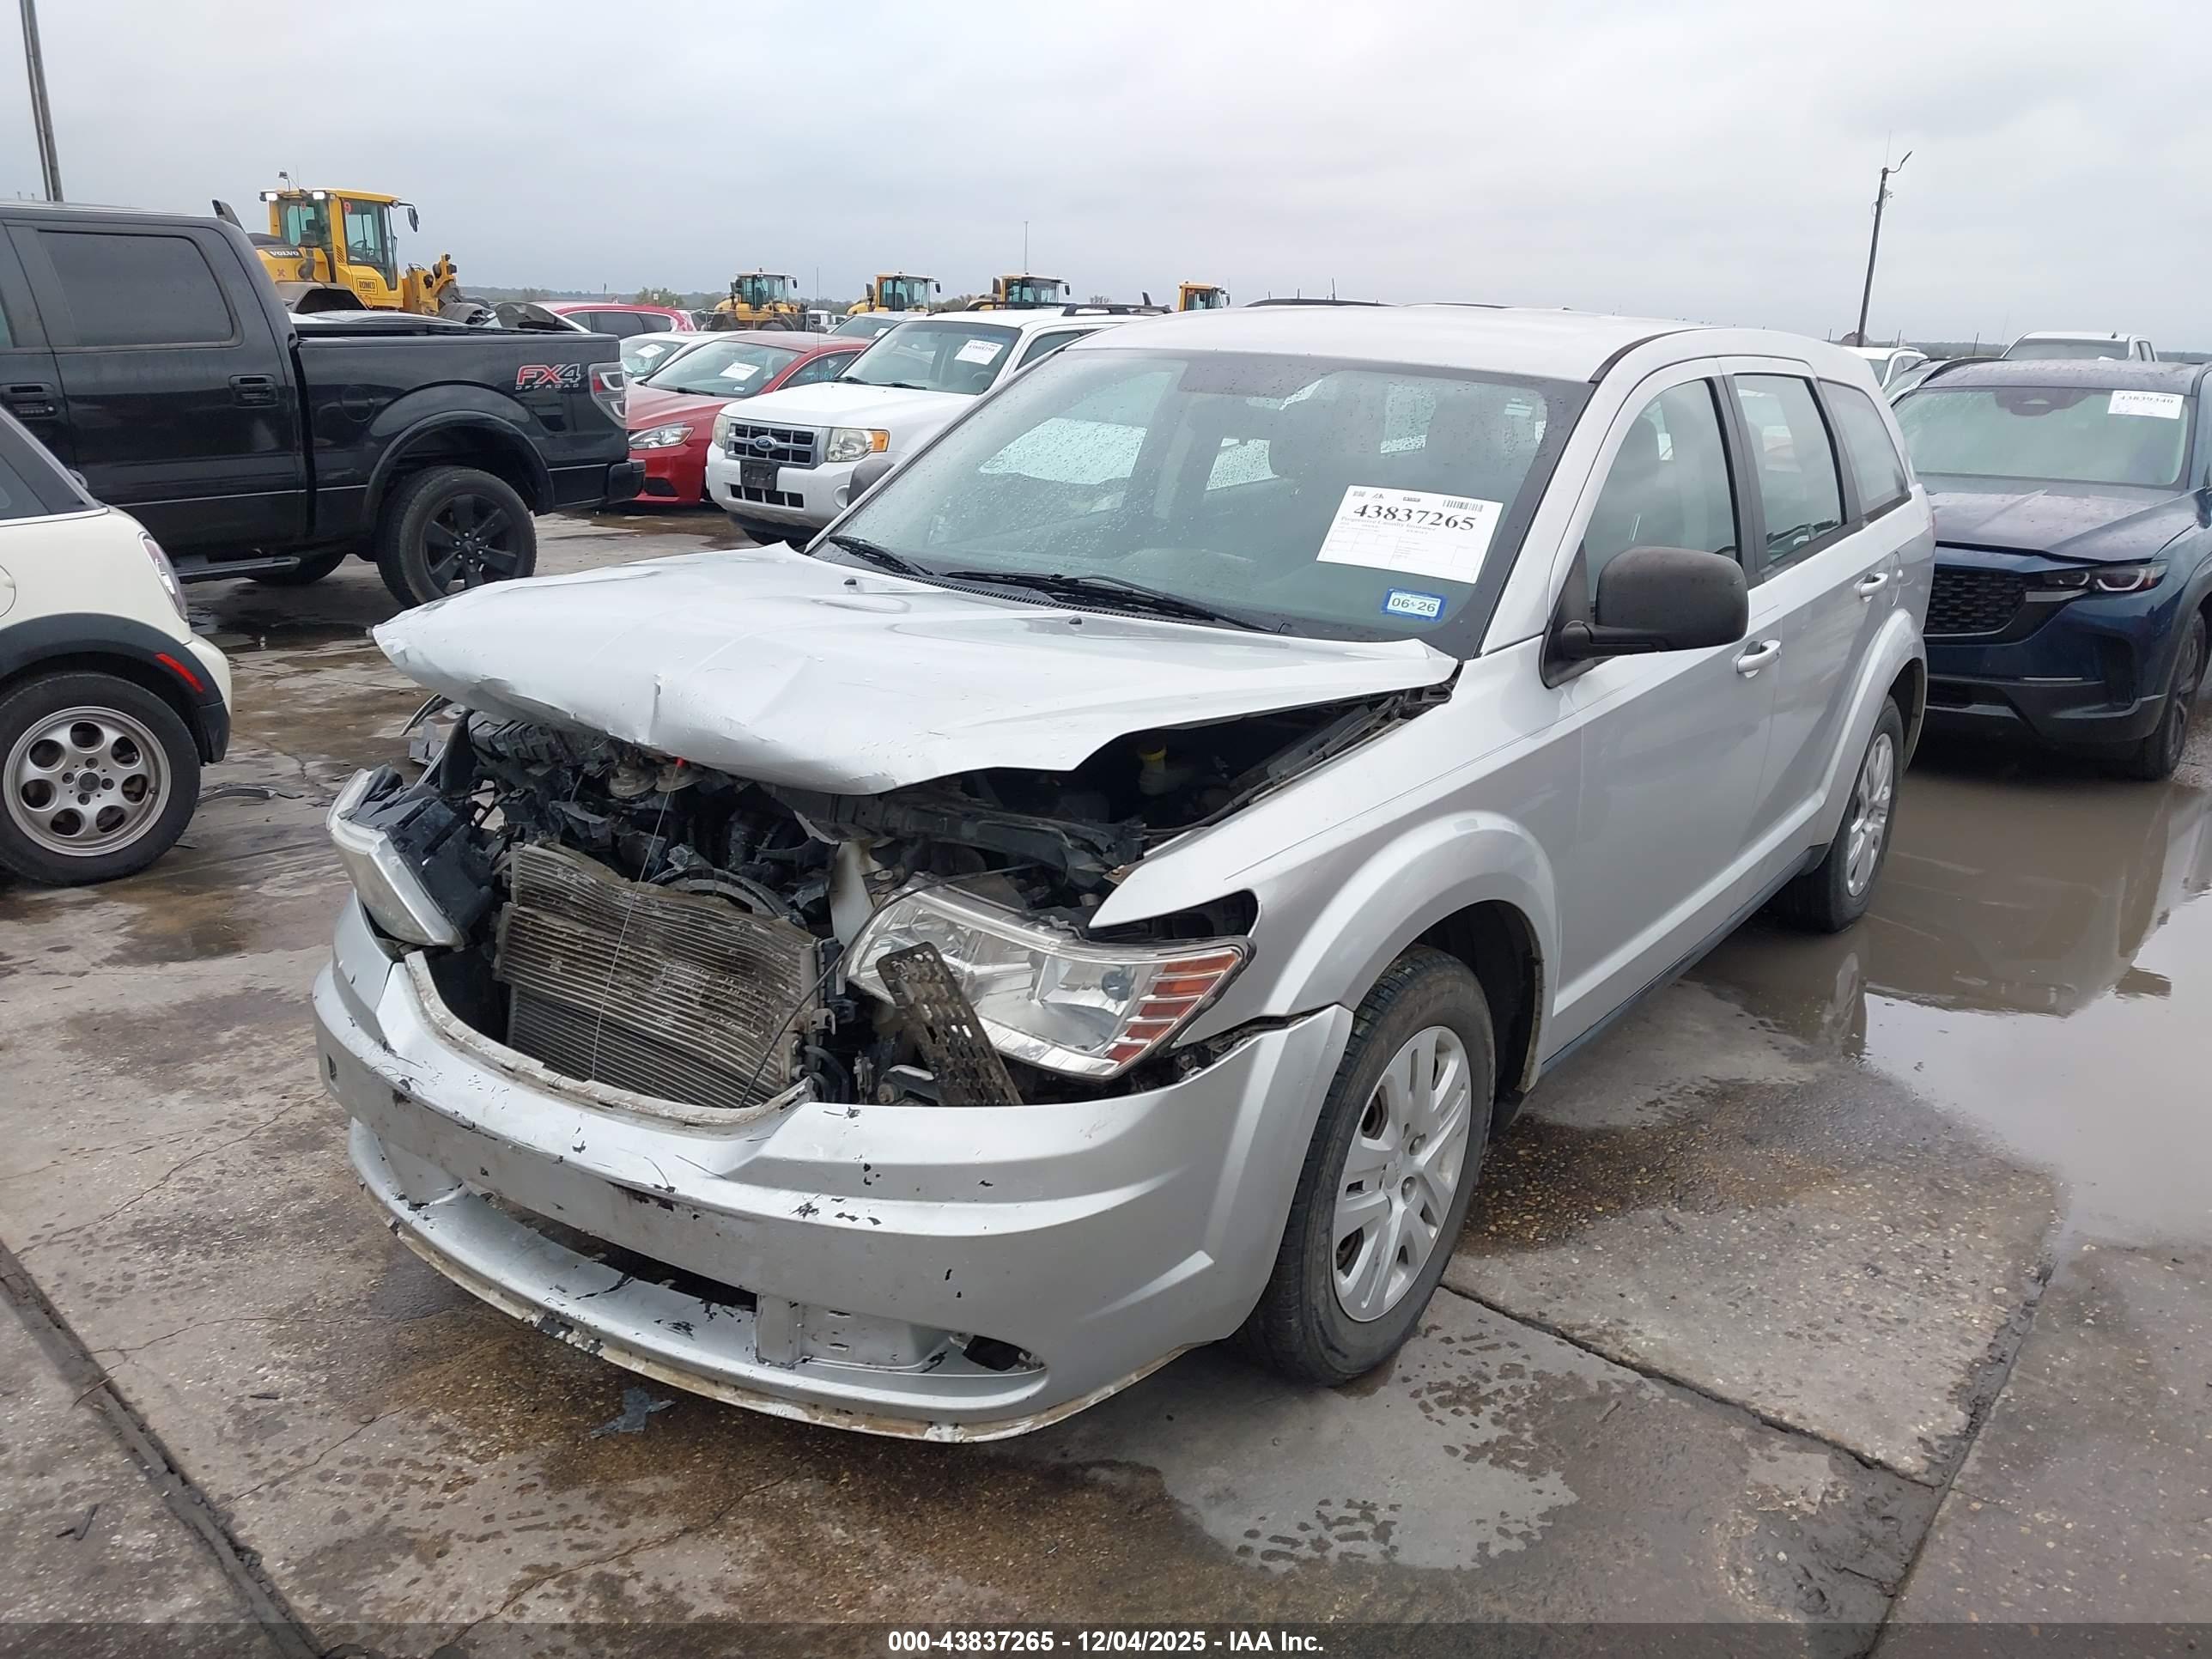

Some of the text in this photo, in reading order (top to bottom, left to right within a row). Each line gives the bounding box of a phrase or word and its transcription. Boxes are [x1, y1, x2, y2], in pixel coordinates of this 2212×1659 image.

[516, 363, 581, 386] FX4
[1353, 504, 1477, 531] 43837265
[1392, 598, 1436, 612] 06 26
